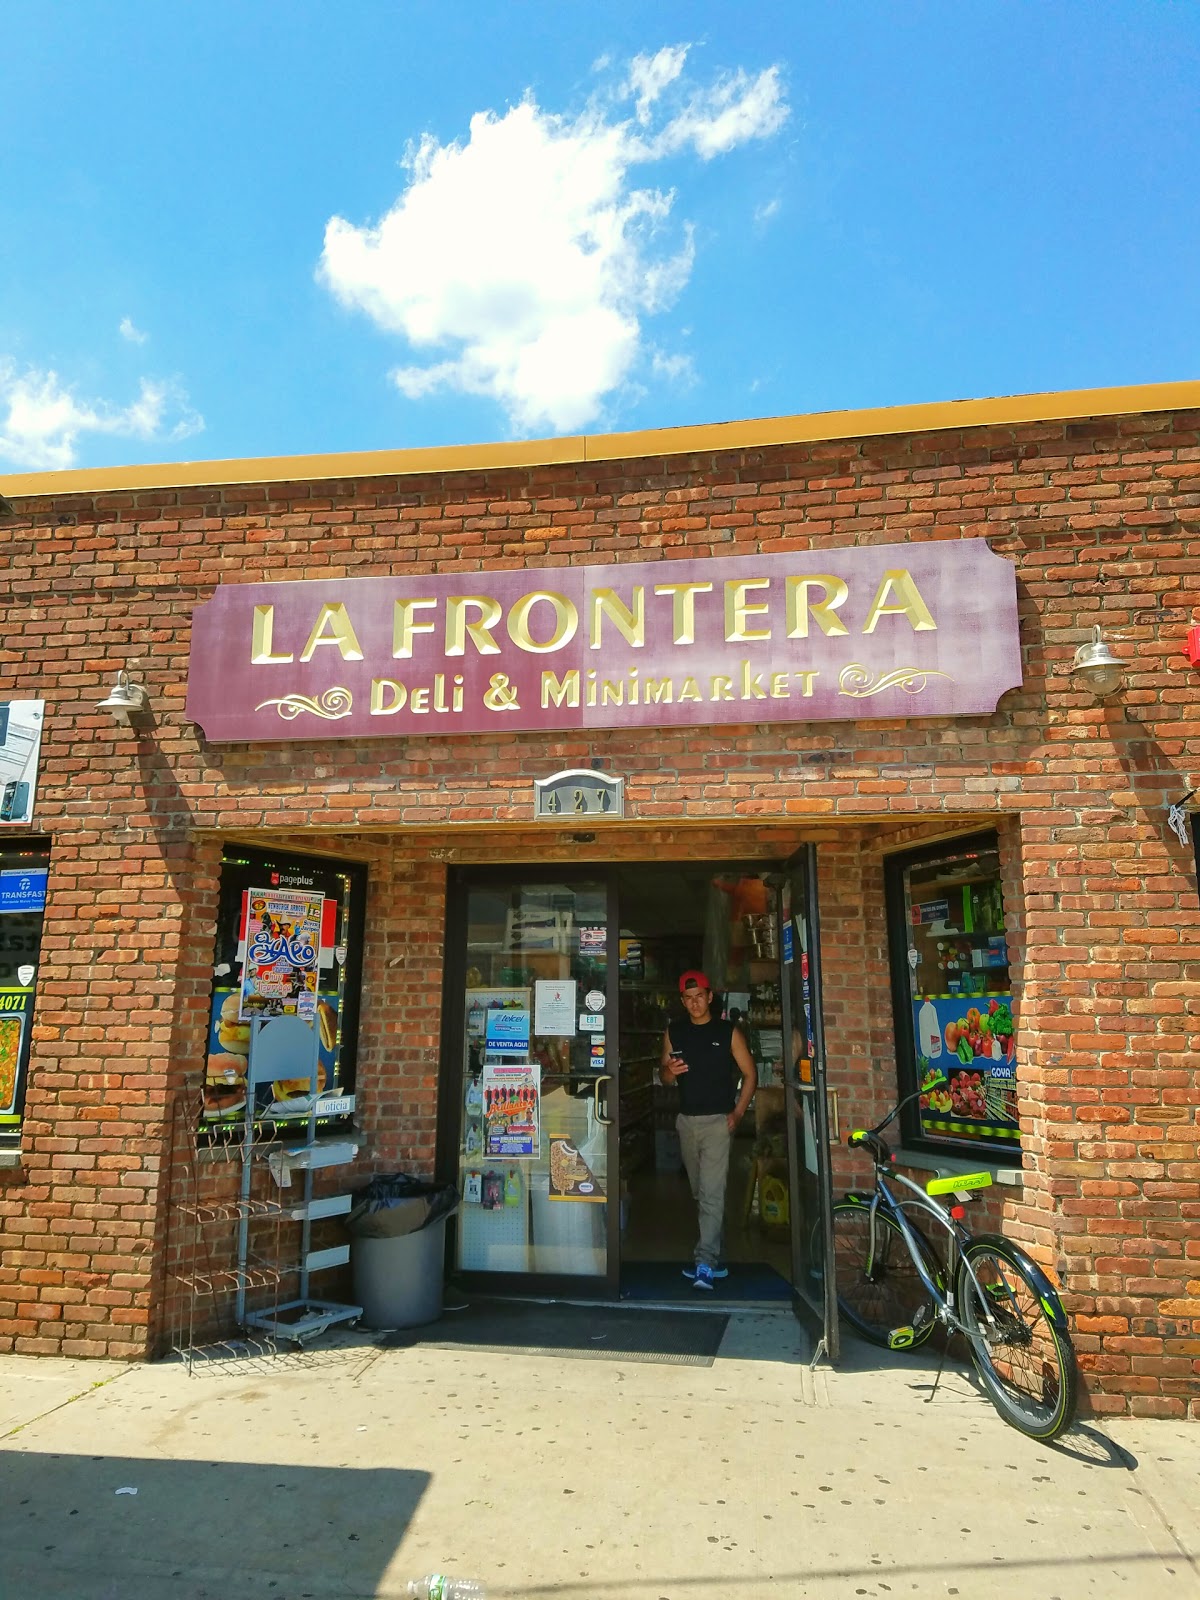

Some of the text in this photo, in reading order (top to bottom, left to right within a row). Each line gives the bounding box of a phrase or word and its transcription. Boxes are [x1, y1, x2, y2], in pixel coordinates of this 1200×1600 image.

[251, 569, 938, 664] LA FRONTERA
[483, 672, 521, 712] &
[547, 788, 606, 813] 427
[280, 875, 314, 886] pageplus
[309, 908, 320, 917] 12
[501, 1014, 526, 1023] telcel
[991, 1067, 1011, 1078] GOYA
